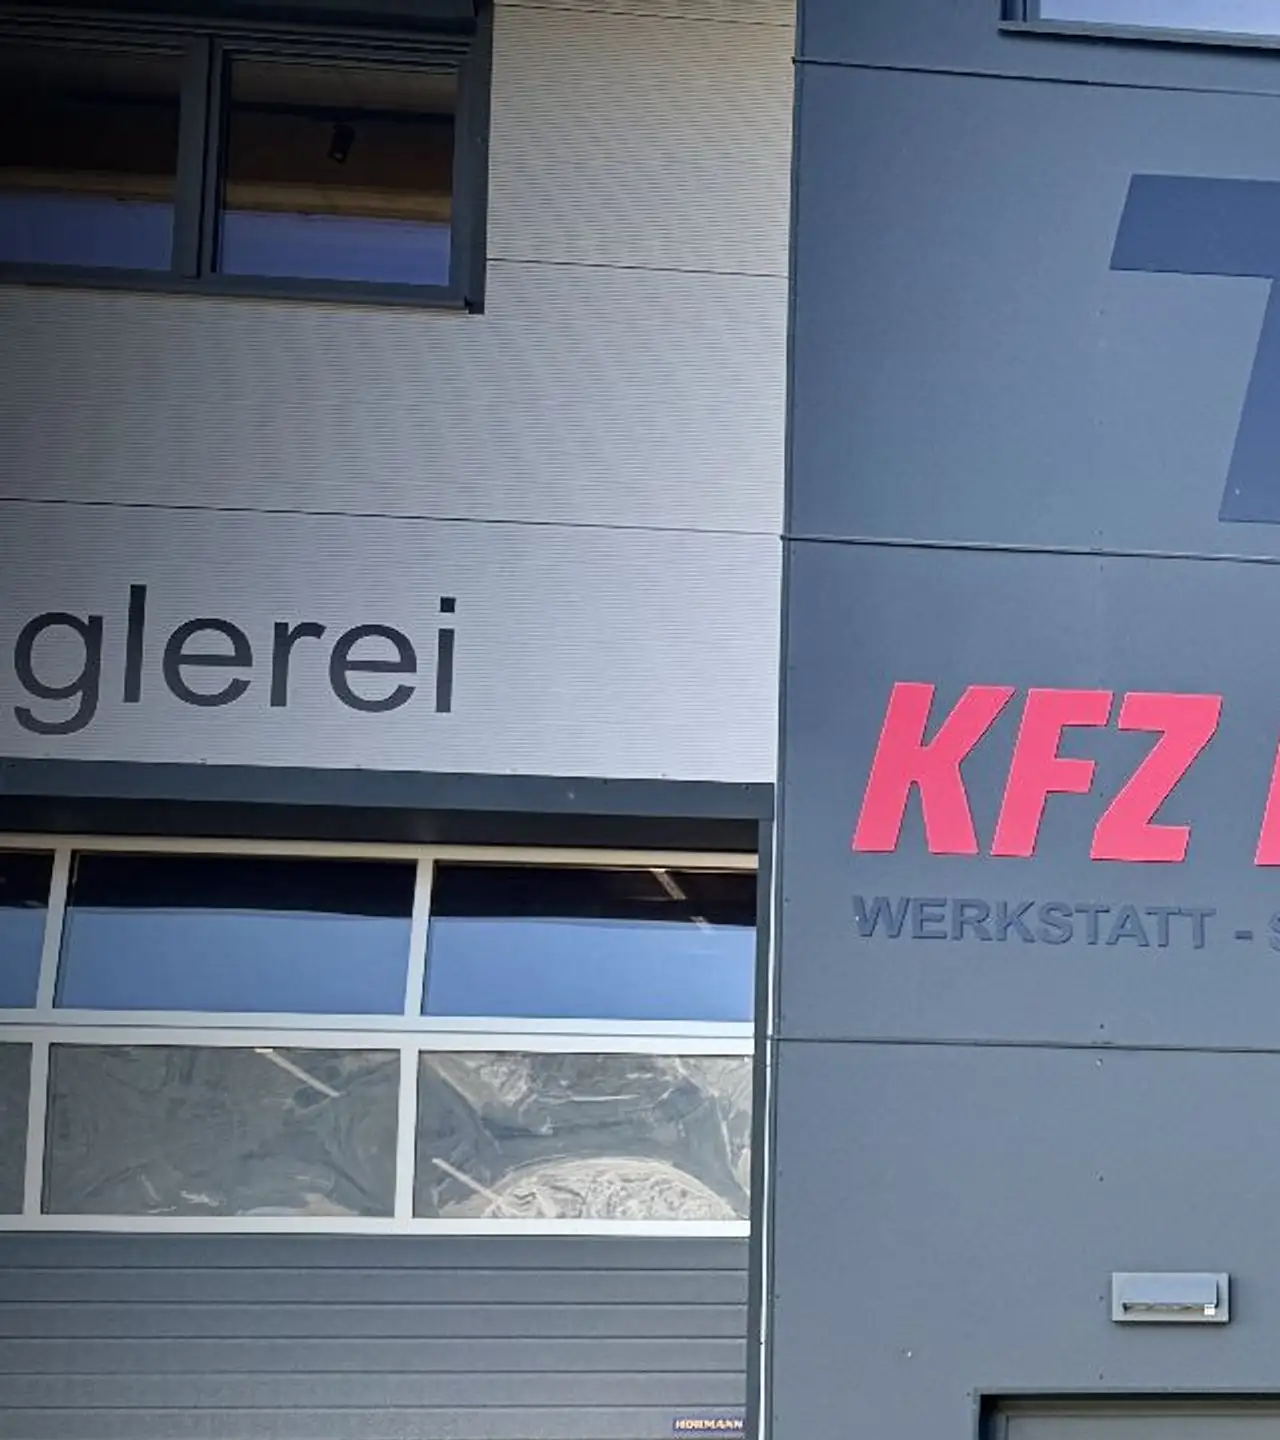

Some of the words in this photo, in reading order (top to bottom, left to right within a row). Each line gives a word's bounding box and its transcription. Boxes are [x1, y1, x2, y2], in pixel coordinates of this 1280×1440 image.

[13, 584, 457, 736] glerei
[853, 682, 1222, 863] KFZ
[852, 895, 1217, 949] WERKSTATT
